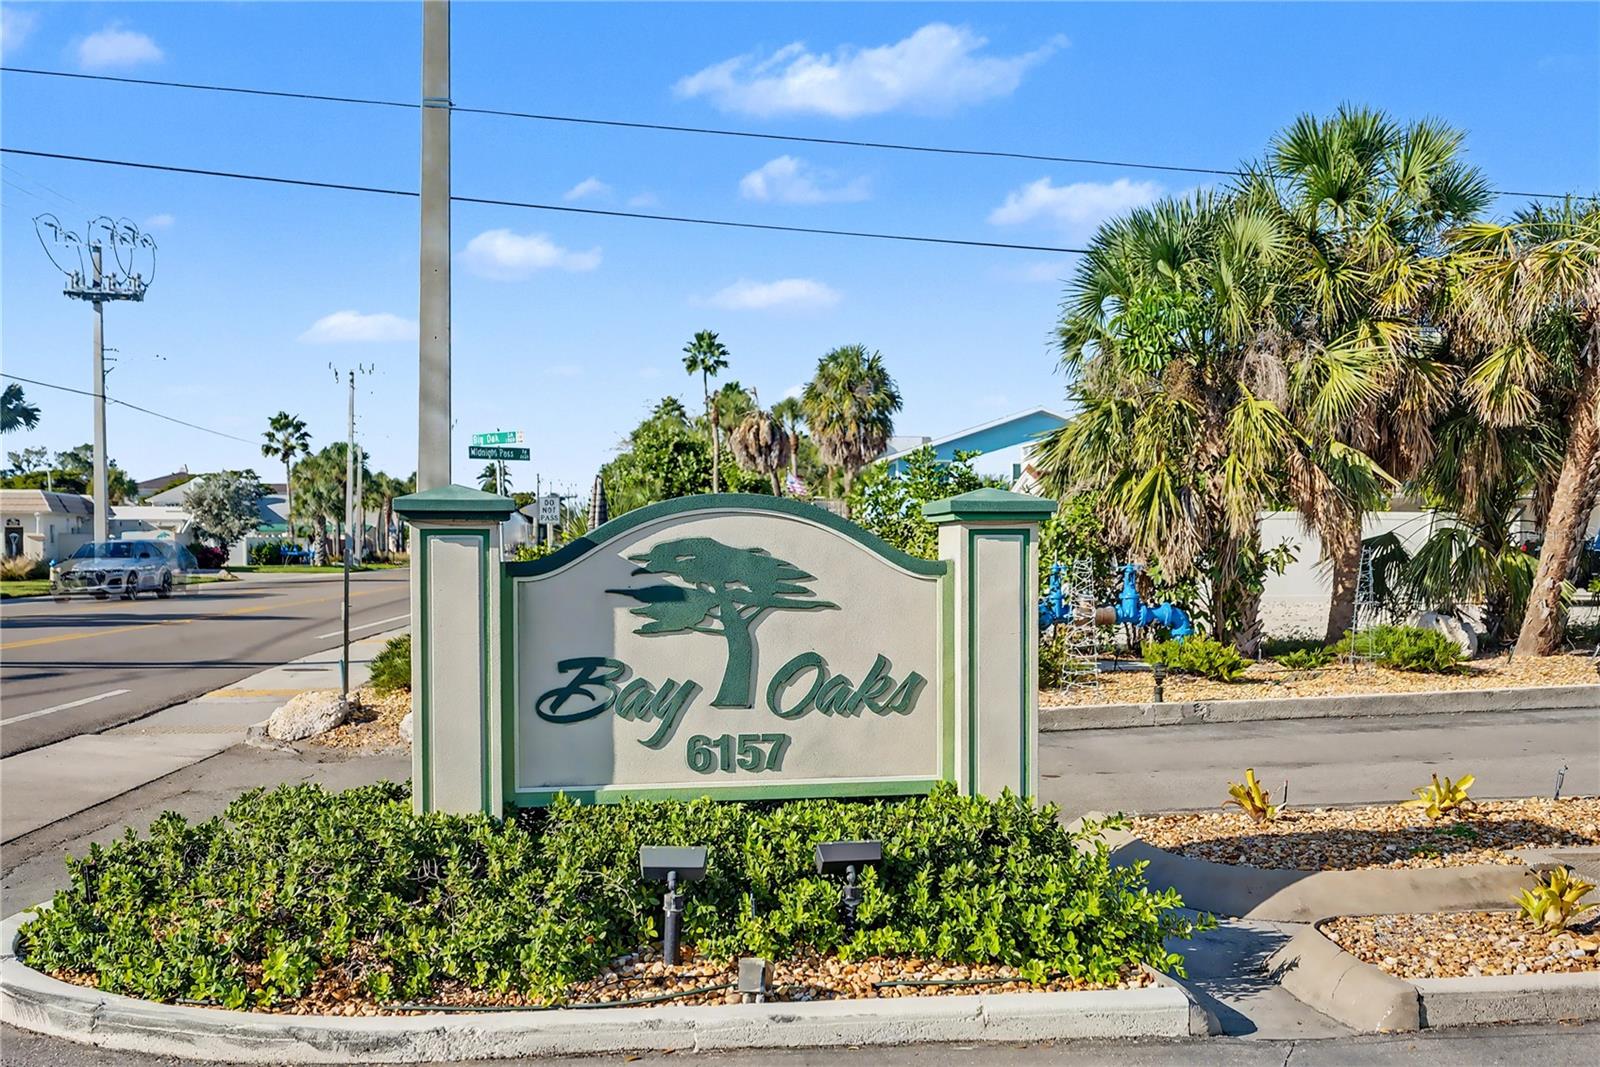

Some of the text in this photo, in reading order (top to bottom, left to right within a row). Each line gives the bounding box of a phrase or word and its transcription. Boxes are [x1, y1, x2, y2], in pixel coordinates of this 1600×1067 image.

[470, 447, 497, 459] Midnight
[499, 448, 514, 458] Pass
[542, 506, 556, 514] NOT
[535, 651, 927, 750] Bay Oaks
[686, 733, 791, 774] 6157
